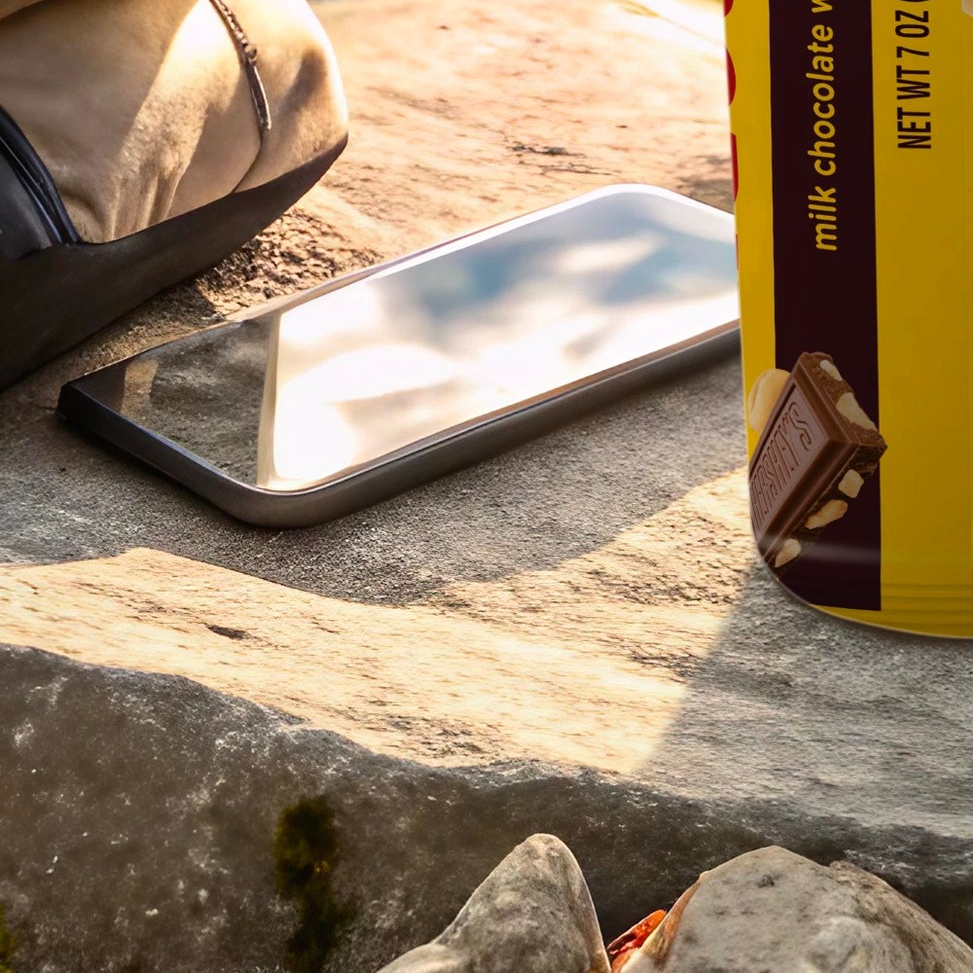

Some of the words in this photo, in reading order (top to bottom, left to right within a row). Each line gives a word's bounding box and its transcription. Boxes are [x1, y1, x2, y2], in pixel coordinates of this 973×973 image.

[894, 11, 929, 38] OZ
[896, 47, 929, 58] 7
[806, 24, 836, 176] chocolate
[896, 65, 930, 100] WT
[896, 107, 932, 150] NET
[808, 186, 837, 251] milk
